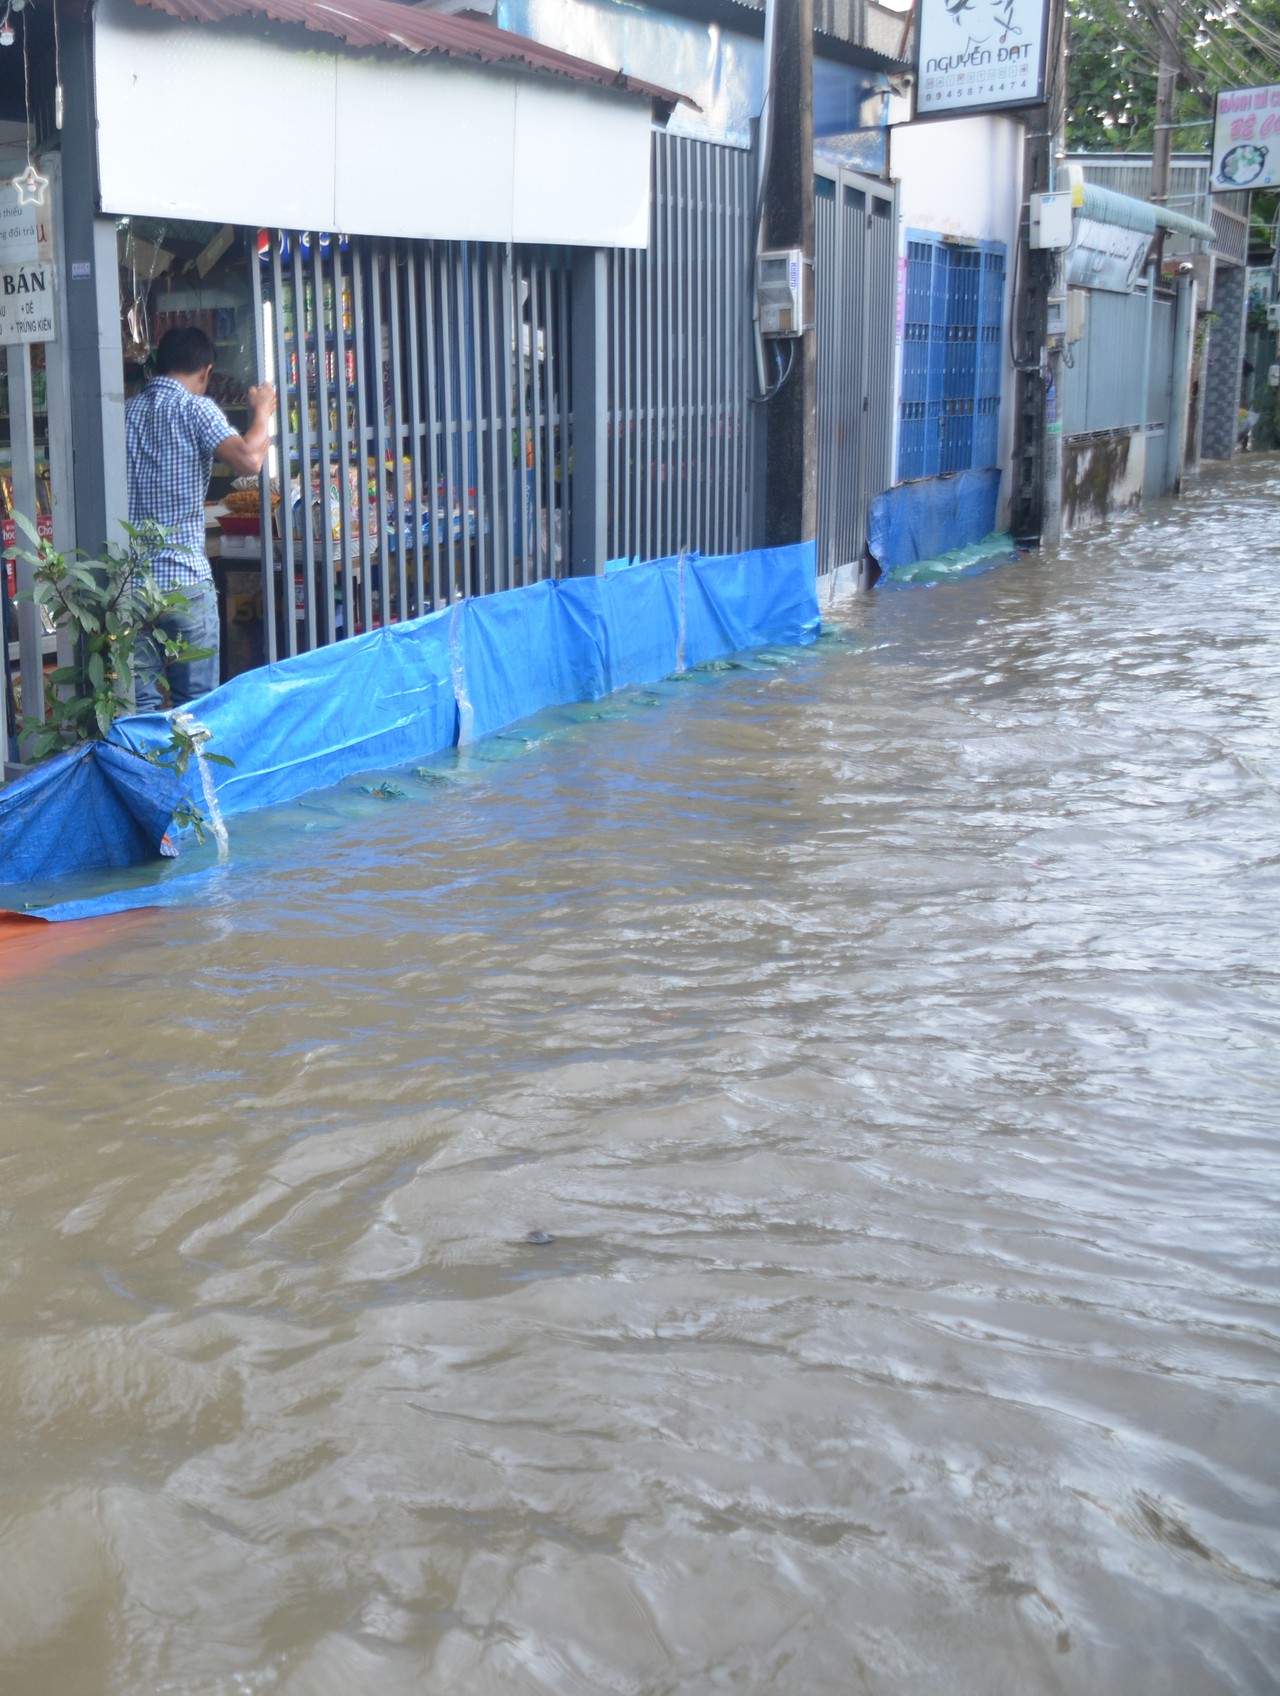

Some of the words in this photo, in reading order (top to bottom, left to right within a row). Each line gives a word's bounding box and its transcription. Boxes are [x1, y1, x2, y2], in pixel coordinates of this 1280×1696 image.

[926, 46, 991, 73] NGUYỄN
[997, 43, 1032, 63] ĐẠT
[3, 267, 46, 295] BÁN
